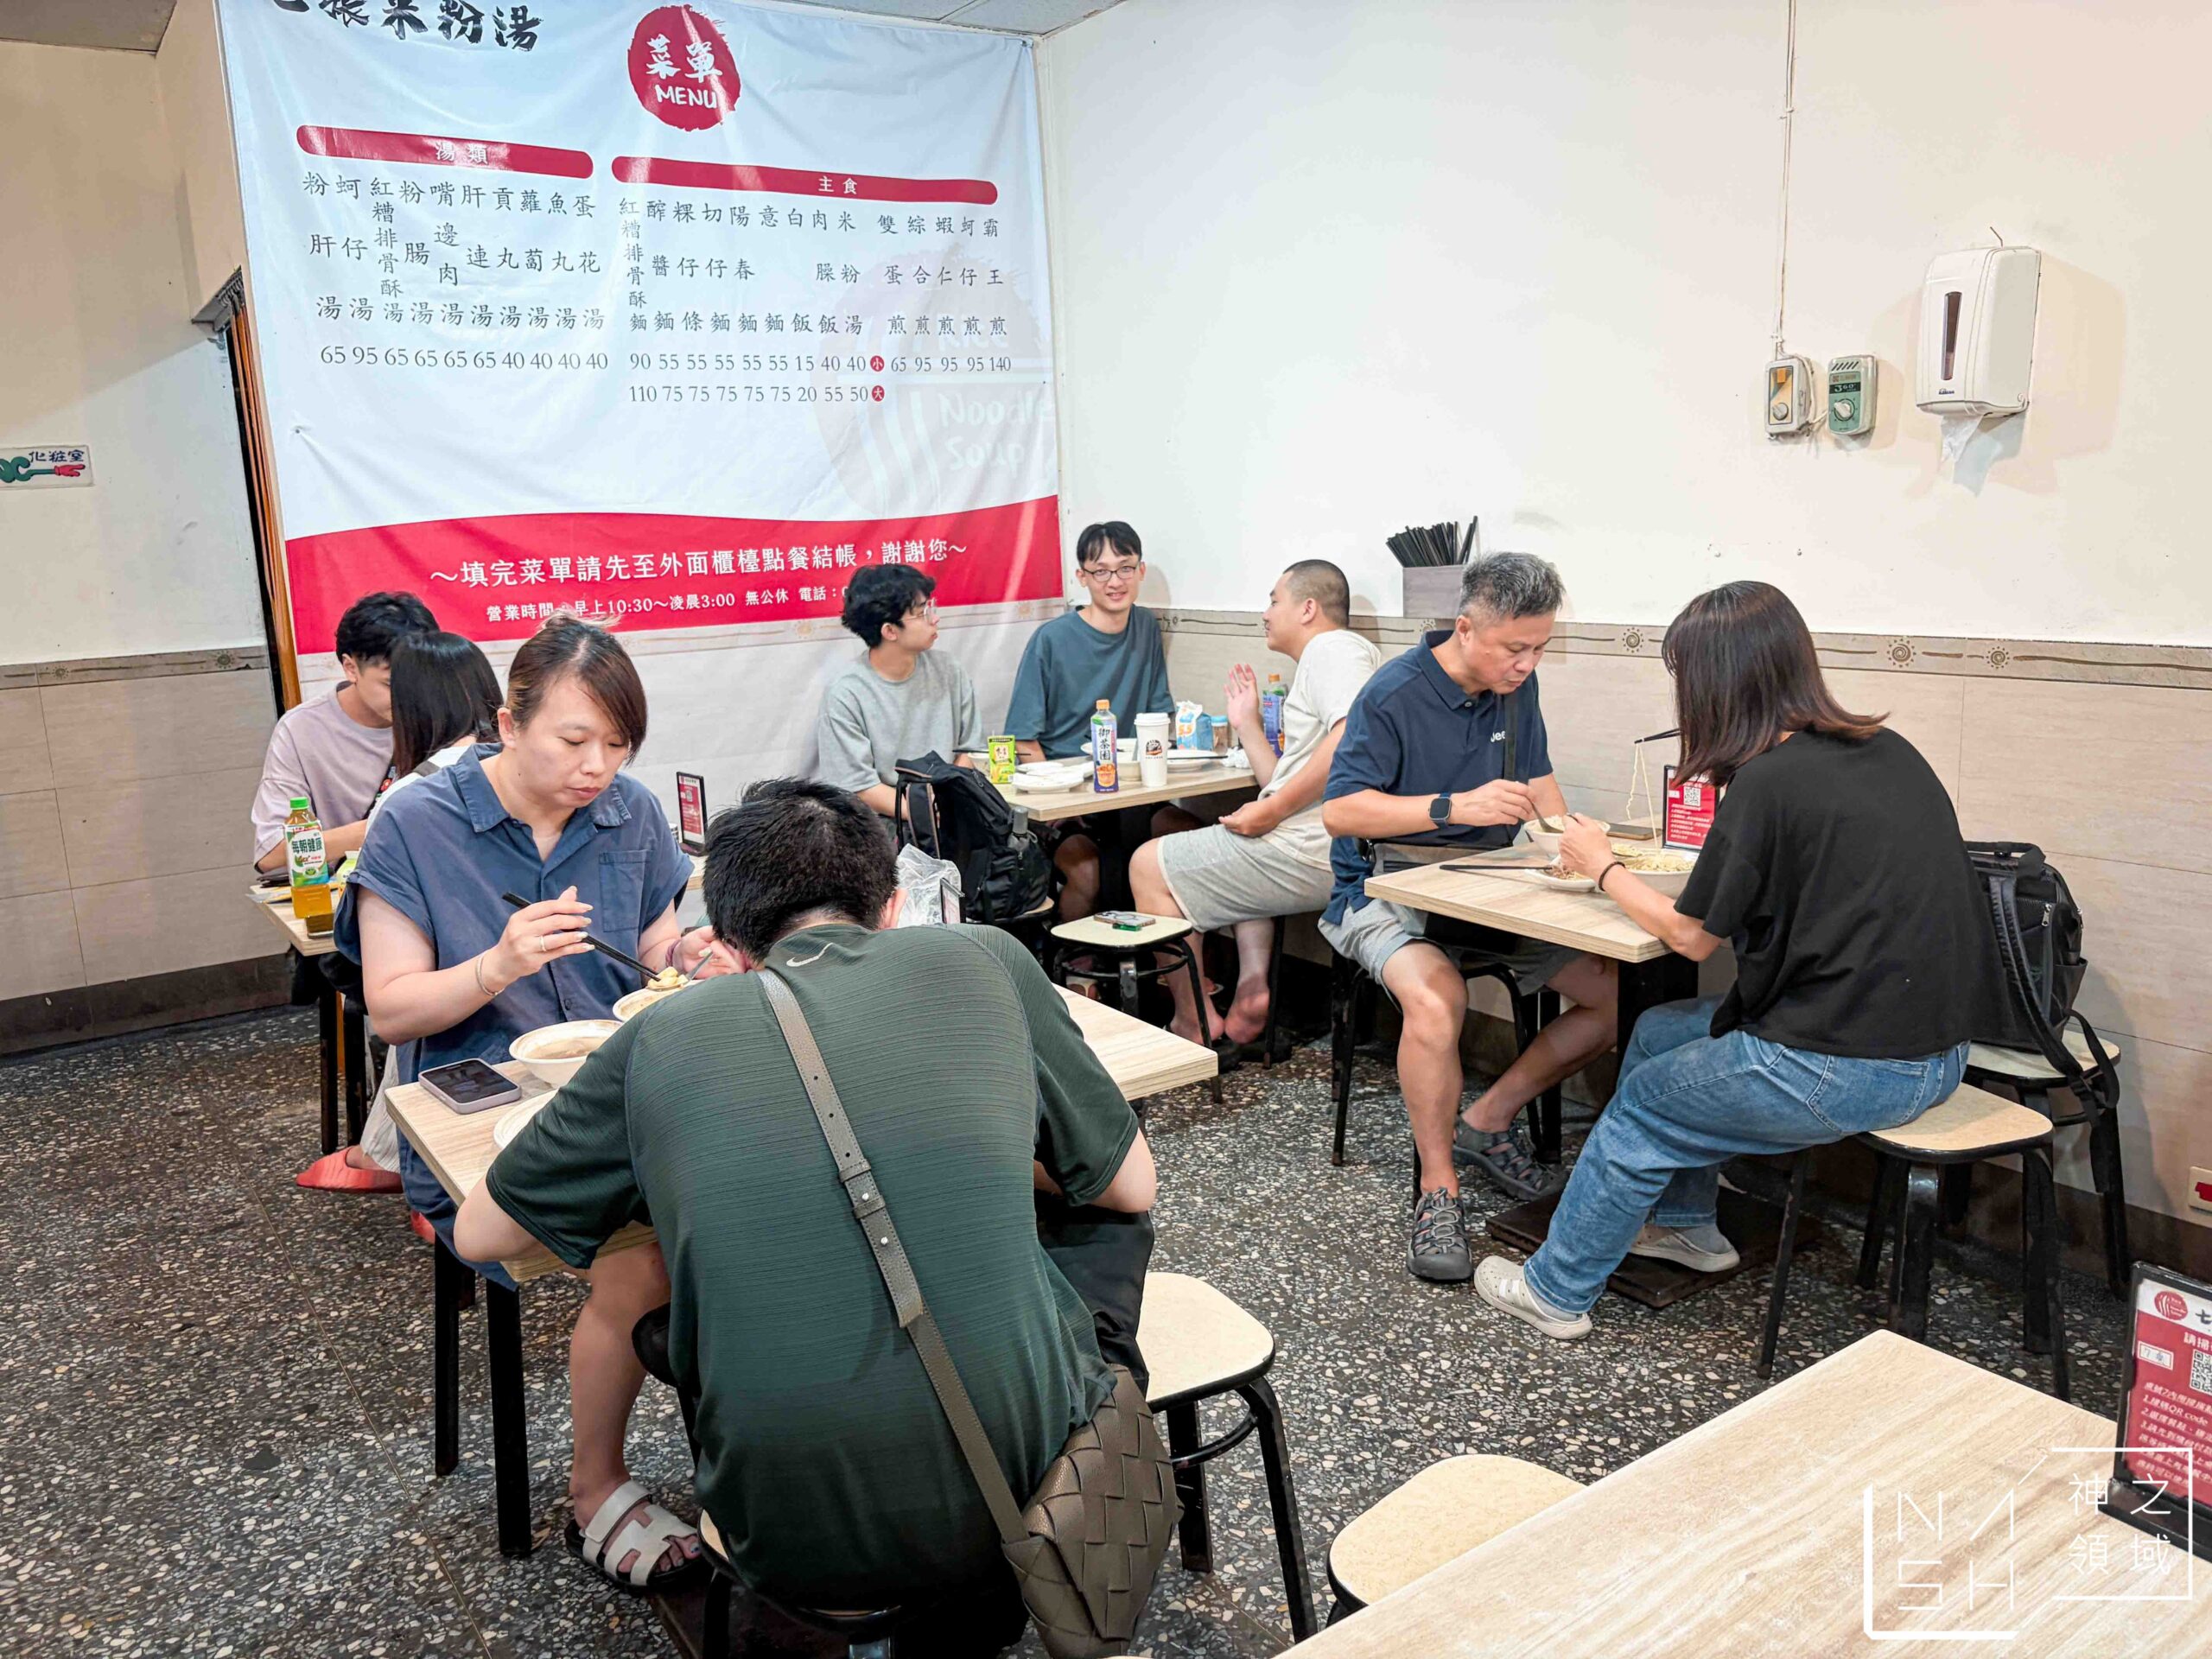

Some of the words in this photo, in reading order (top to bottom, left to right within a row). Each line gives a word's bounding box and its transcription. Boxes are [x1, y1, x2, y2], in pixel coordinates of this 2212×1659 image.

[273, 0, 543, 51] 米粉湯
[645, 34, 722, 83] 菜單
[435, 140, 487, 165] 湯類
[655, 85, 717, 109] MENU
[818, 175, 857, 194] 主食
[302, 172, 343, 321] 粉肝湯
[335, 175, 374, 321] 蚵仔湯
[398, 181, 435, 325] 粉腸湯
[461, 184, 493, 327] 肝連湯
[493, 187, 522, 328] 貢丸湯
[548, 191, 576, 330] 魚丸湯
[572, 194, 605, 330] 蛋花湯
[702, 203, 730, 333] 切仔麵
[729, 206, 757, 333] 陽春麵
[837, 211, 863, 335] 米粉湯
[936, 216, 955, 336] 蝦仁煎
[960, 216, 982, 336] 蚵仔煎
[982, 219, 1007, 336] 霸王煎
[321, 346, 346, 364] 65
[353, 346, 378, 365] 95
[385, 347, 409, 365] 65
[415, 349, 438, 367] 65
[444, 350, 467, 368] 65
[474, 351, 496, 369] 65
[502, 352, 524, 369] 40
[531, 353, 553, 369] 40
[558, 353, 581, 369] 40
[586, 353, 608, 370] 40
[629, 385, 657, 402] 110
[662, 386, 683, 402] 75
[689, 386, 709, 402] 75
[716, 386, 737, 402] 75
[744, 386, 765, 402] 75
[771, 386, 791, 402] 75
[798, 386, 817, 403] 20
[824, 386, 843, 403] 55
[850, 386, 868, 403] 50
[873, 388, 884, 400] 大
[630, 353, 651, 370] 90
[659, 354, 679, 370] 55
[687, 354, 707, 370] 55
[715, 355, 734, 371] 55
[742, 355, 762, 371] 55
[768, 356, 788, 371] 55
[795, 356, 815, 372] 15
[821, 356, 841, 372] 40
[847, 356, 867, 372] 40
[872, 357, 883, 369] 小
[891, 357, 906, 372] 65
[915, 357, 931, 372] 95
[941, 357, 958, 372] 95
[967, 357, 984, 372] 95
[989, 357, 1011, 372] 140
[29, 449, 85, 463] 化粧室
[746, 588, 789, 606] 無公休
[1491, 730, 1506, 743] Jee
